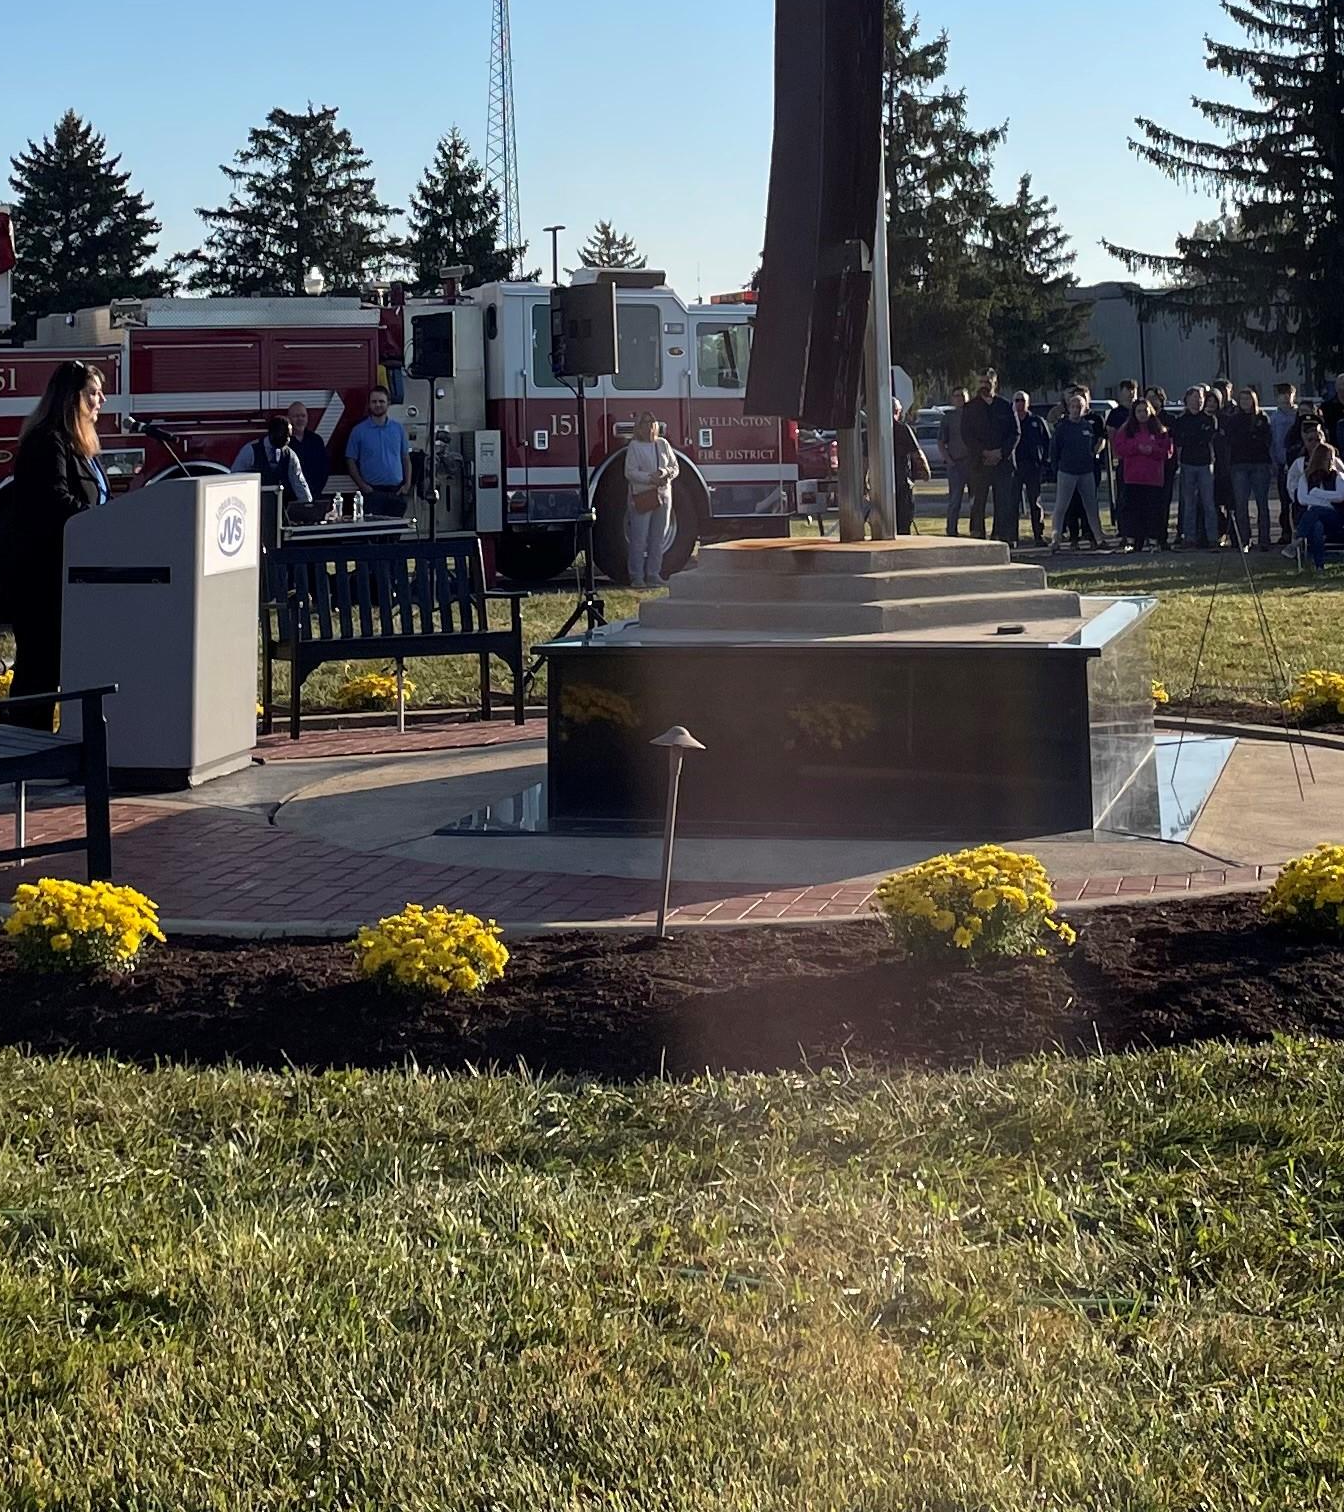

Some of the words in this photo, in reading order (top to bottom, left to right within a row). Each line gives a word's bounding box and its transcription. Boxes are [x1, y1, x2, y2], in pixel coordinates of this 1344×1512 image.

[550, 414, 579, 436] 151
[698, 416, 772, 427] WELLINGTON
[698, 450, 721, 460] FIRE
[726, 449, 775, 460] DISTRICT
[219, 515, 242, 545] JVS
